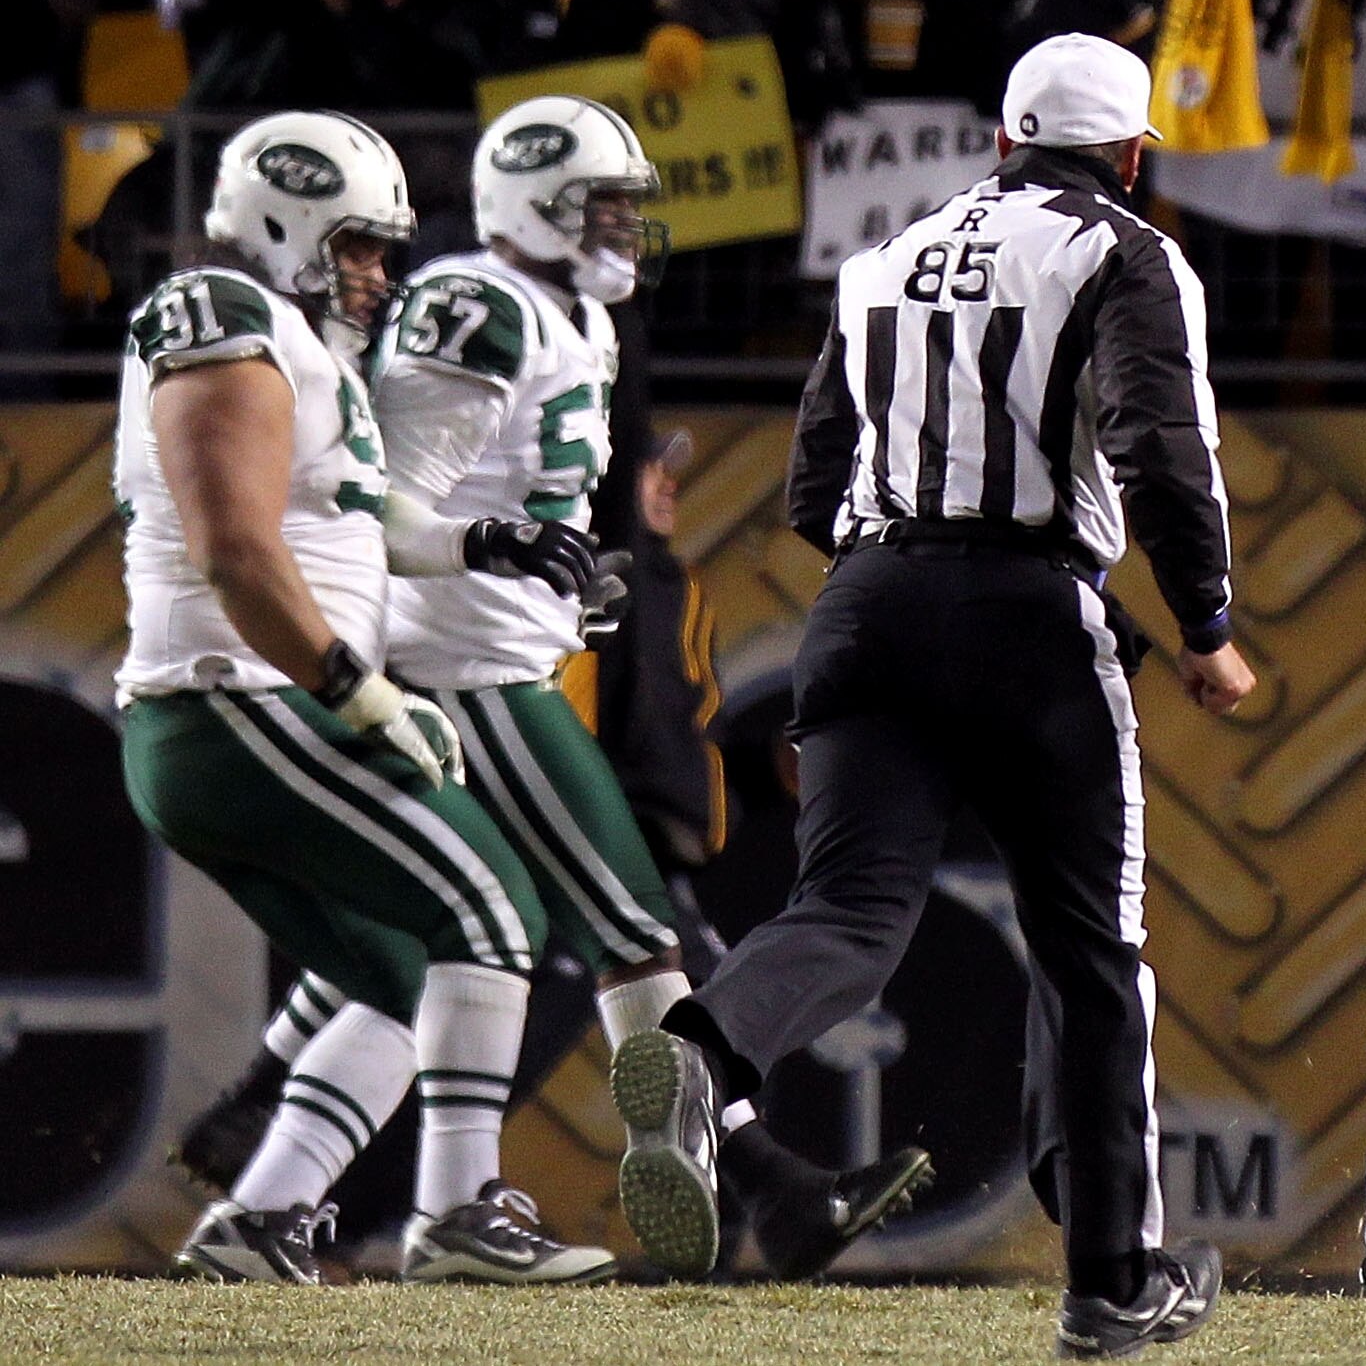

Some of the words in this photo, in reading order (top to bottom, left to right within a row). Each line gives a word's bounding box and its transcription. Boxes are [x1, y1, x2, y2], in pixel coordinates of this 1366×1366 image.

[821, 125, 992, 173] WARD
[953, 208, 989, 231] R
[904, 241, 1004, 303] 85
[156, 281, 227, 352] 91
[401, 286, 489, 364] 57
